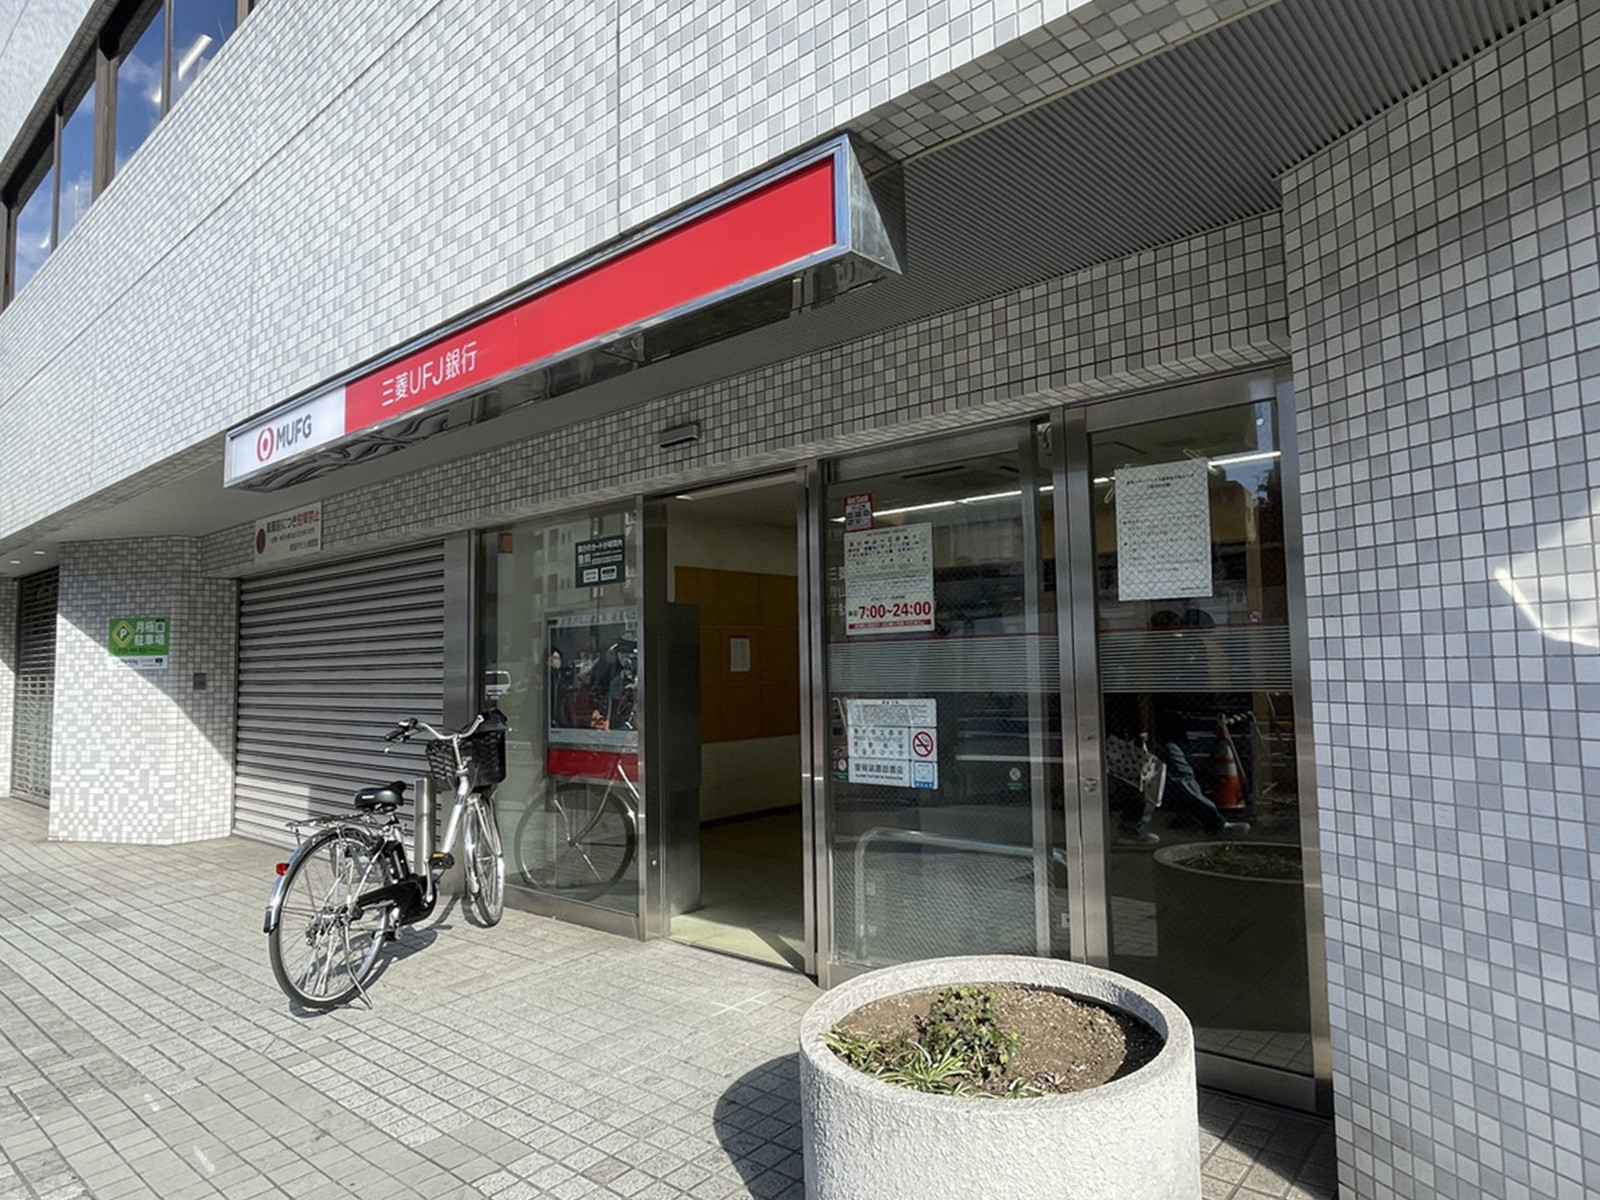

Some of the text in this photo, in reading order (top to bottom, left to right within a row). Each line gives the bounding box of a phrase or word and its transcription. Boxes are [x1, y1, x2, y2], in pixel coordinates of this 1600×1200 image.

[380, 341, 479, 407] 三菱UFJ銀行
[275, 414, 313, 452] MUFG
